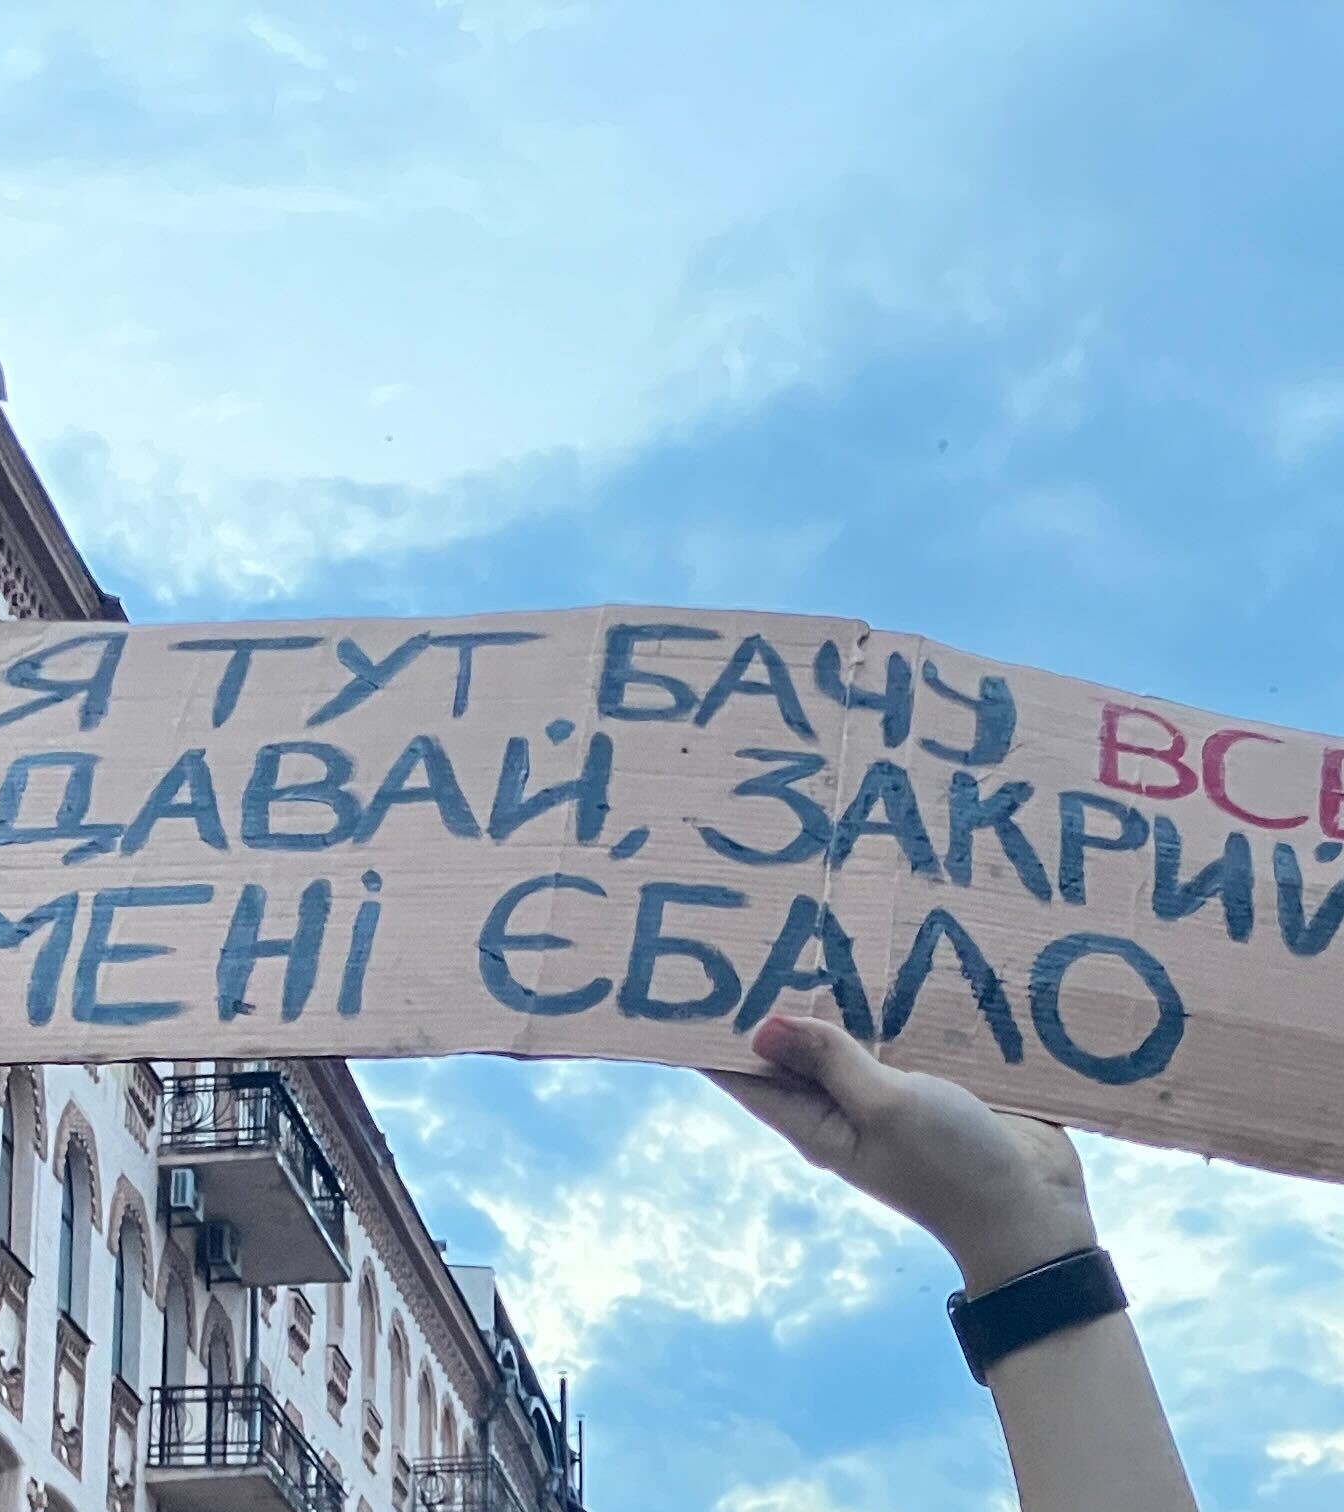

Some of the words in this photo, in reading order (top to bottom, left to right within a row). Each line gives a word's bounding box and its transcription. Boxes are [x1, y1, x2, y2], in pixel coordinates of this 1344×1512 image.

[171, 630, 548, 729] ТУТ
[598, 622, 1018, 767] БАЧУ
[477, 873, 1189, 1085] ЄБАЛО
